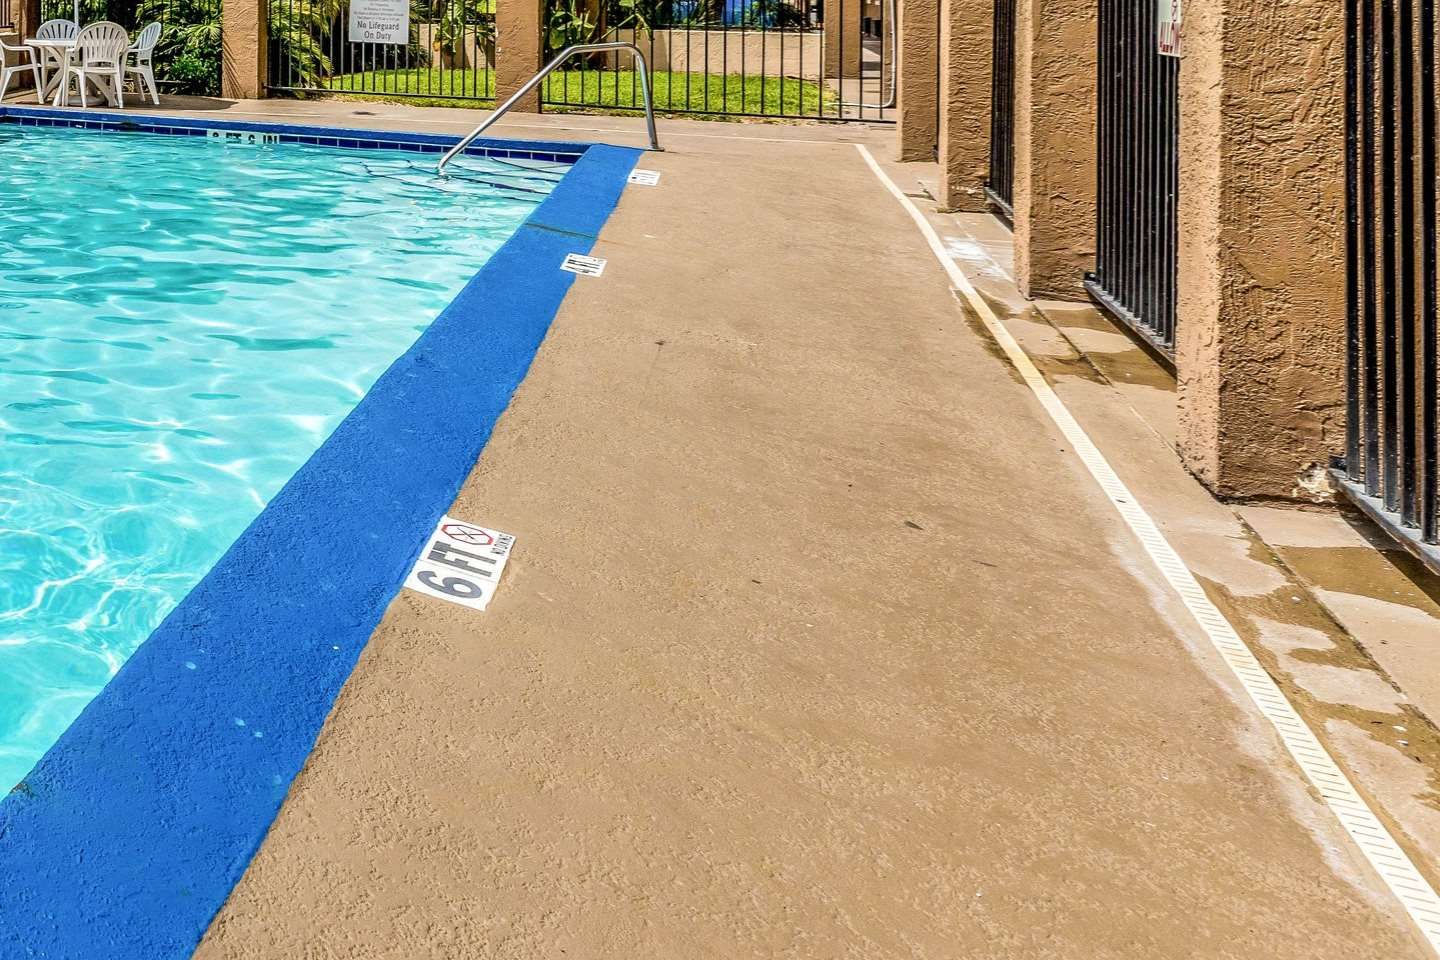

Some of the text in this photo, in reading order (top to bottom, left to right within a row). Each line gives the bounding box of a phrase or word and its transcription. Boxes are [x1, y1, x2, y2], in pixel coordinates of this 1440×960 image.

[357, 21, 400, 31] No Lifeguard
[364, 31, 392, 40] On Duty
[417, 540, 497, 599] 6 FT
